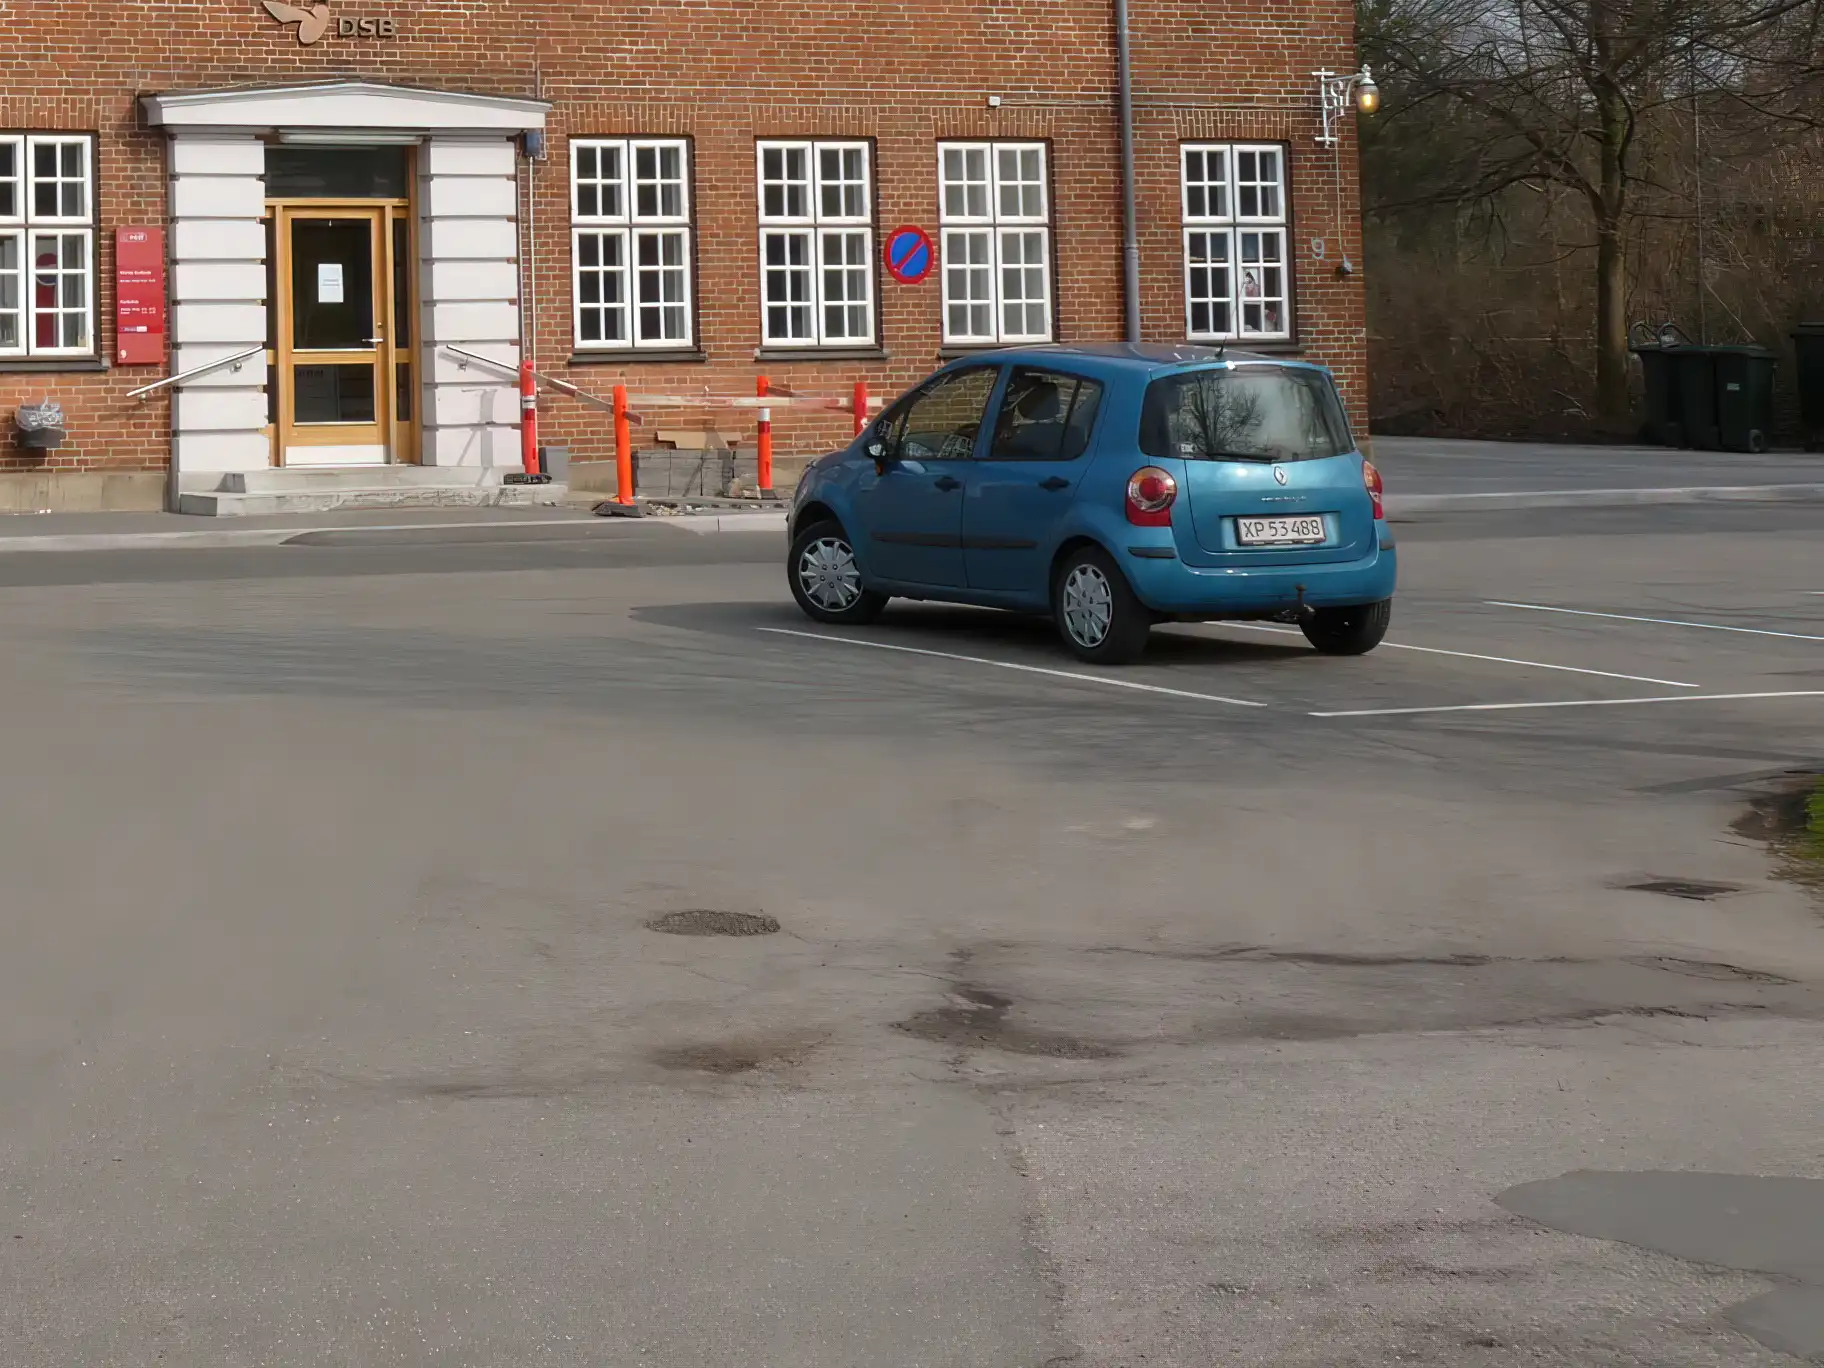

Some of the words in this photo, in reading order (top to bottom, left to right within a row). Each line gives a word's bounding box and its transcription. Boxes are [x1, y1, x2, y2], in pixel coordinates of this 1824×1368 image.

[339, 16, 396, 37] DSB
[1242, 521, 1265, 538] XP
[1268, 521, 1289, 537] 53
[1291, 520, 1321, 537] 488
